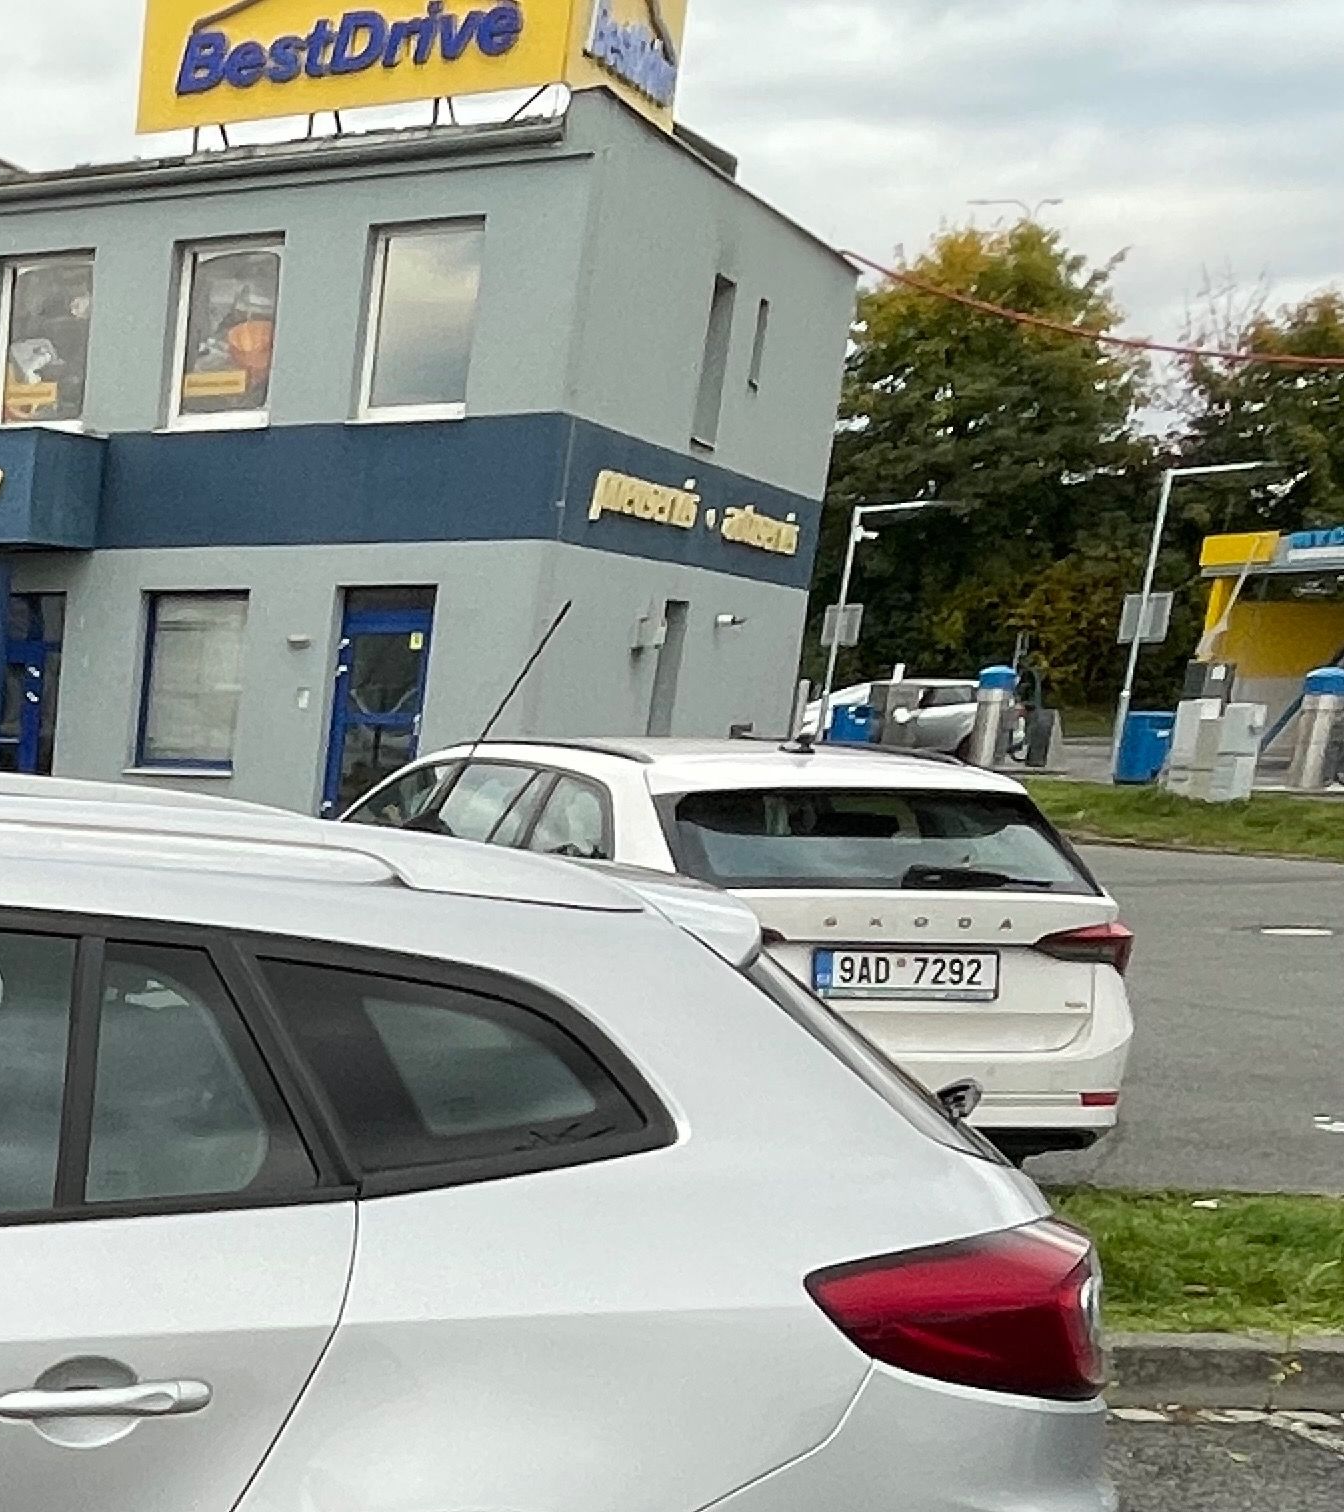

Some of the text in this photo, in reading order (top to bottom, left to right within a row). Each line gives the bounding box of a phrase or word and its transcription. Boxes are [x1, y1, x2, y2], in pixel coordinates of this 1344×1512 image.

[176, 0, 524, 96] BestDrive
[838, 955, 983, 986] 9AD 7292
